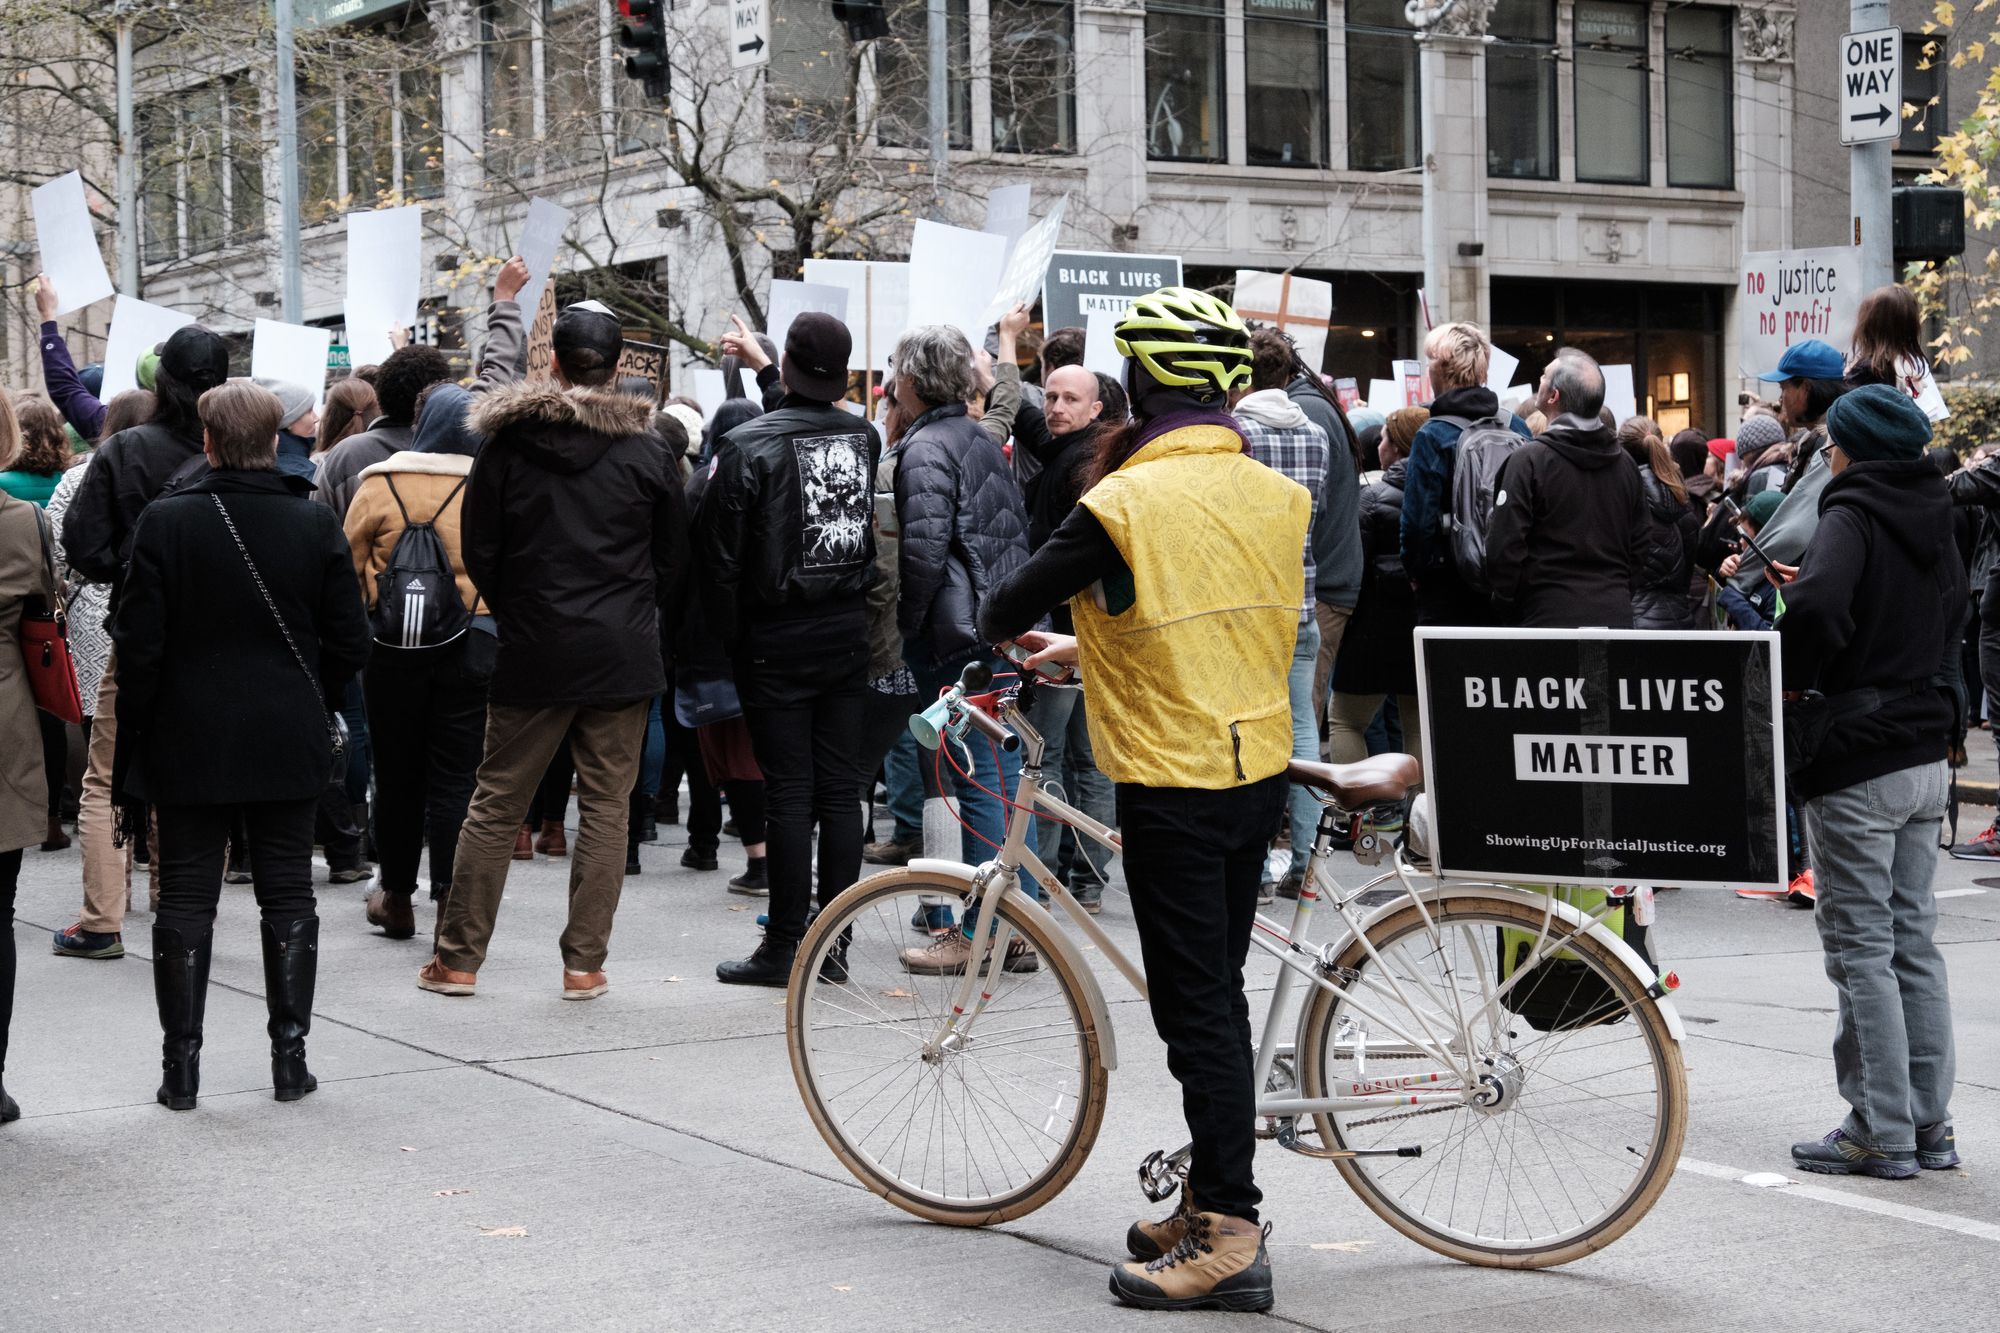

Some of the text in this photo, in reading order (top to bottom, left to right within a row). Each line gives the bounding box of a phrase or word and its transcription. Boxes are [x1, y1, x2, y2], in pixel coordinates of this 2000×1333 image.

[735, 5, 760, 29] WAY
[1580, 22, 1637, 37] DENTISTRY
[1847, 37, 1893, 66] ONE
[1847, 67, 1894, 97] WAY
[1059, 268, 1162, 288] BLACK LIVES
[1747, 260, 1836, 306] no justice
[1086, 298, 1132, 312] MATTE
[1760, 298, 1832, 347] no profit
[1464, 677, 1724, 711] BLACK LIVES
[1531, 742, 1675, 776] MATTER
[1486, 834, 1727, 856] ShowingUpForRacialJustice.org
[1353, 1078, 1411, 1093] PUBLIC
